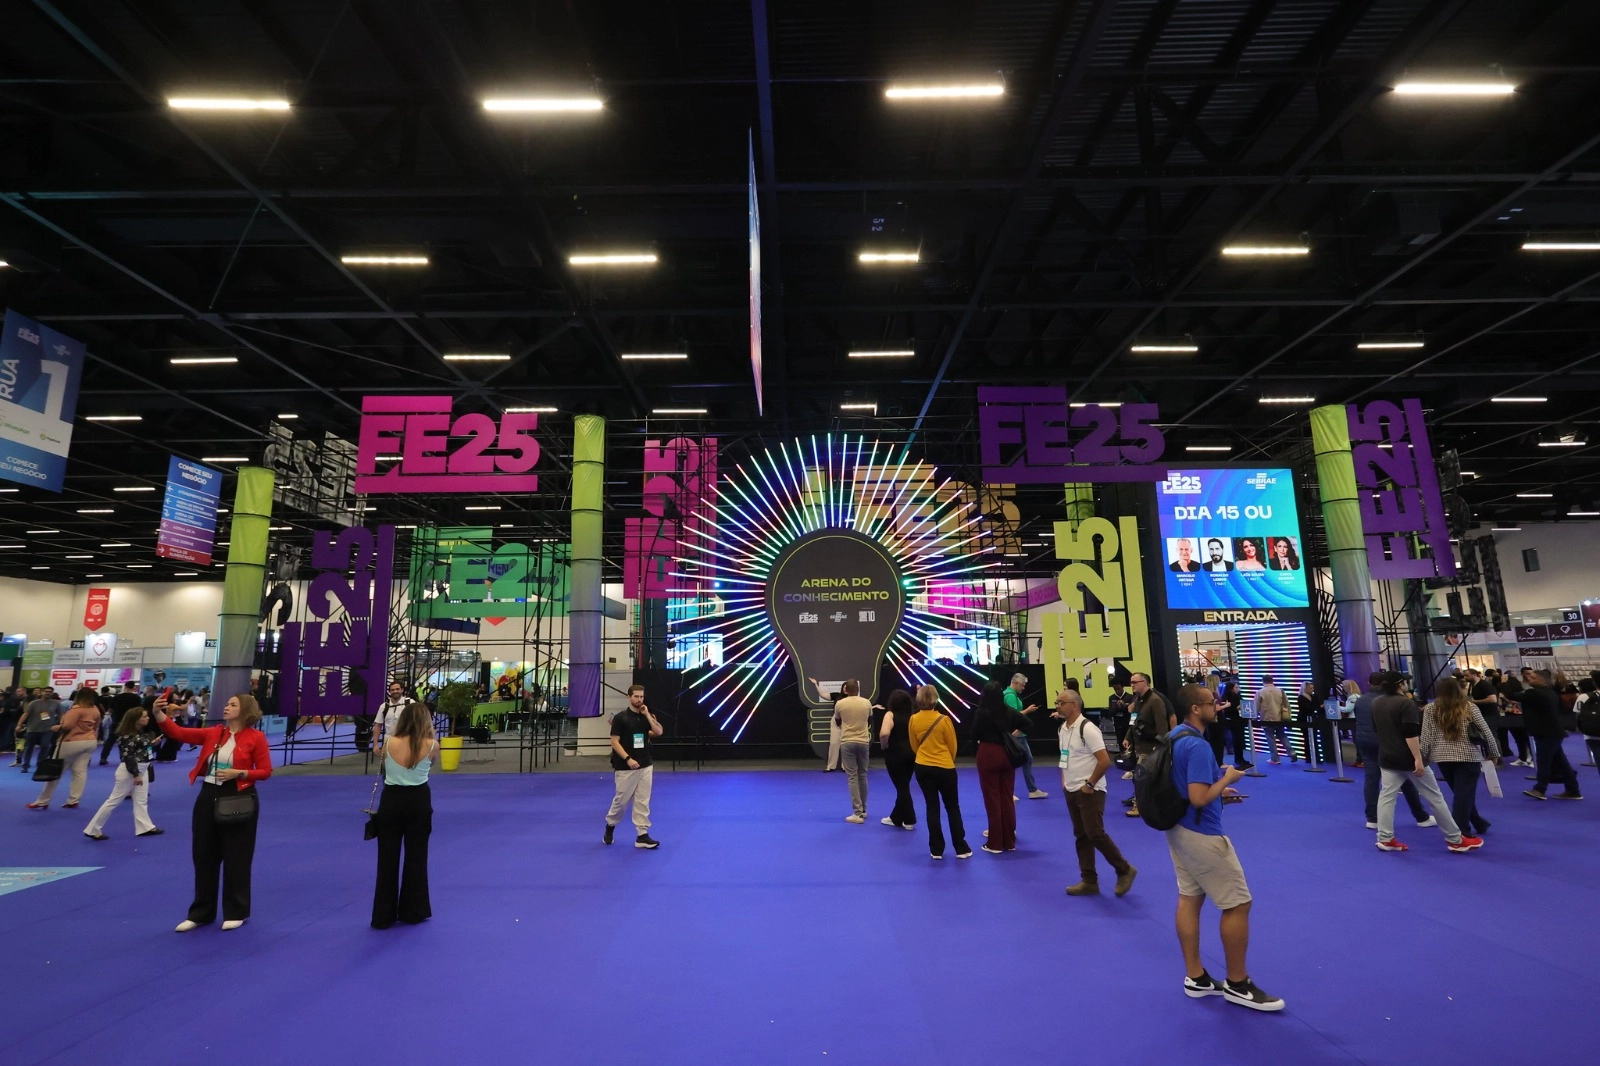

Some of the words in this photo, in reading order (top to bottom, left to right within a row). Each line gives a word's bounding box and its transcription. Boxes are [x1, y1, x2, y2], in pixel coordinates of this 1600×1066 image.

[0, 359, 19, 399] RUA
[41, 359, 69, 420] 1
[980, 403, 1165, 465] FE25
[358, 413, 541, 475] FE25
[7, 456, 38, 470] COMECE
[1162, 476, 1202, 491] FE25
[1246, 477, 1277, 485] SEBRAE
[1174, 506, 1212, 520] DIA
[1216, 505, 1240, 520] 15
[1244, 505, 1273, 519] OU
[801, 578, 849, 588] ARENA
[852, 577, 871, 586] DO
[784, 591, 890, 602] CONHECIMENTO
[1203, 610, 1278, 622] ENTRADA
[1567, 612, 1578, 620] 30
[1181, 658, 1208, 667] BITOS
[476, 712, 499, 726] AREN
